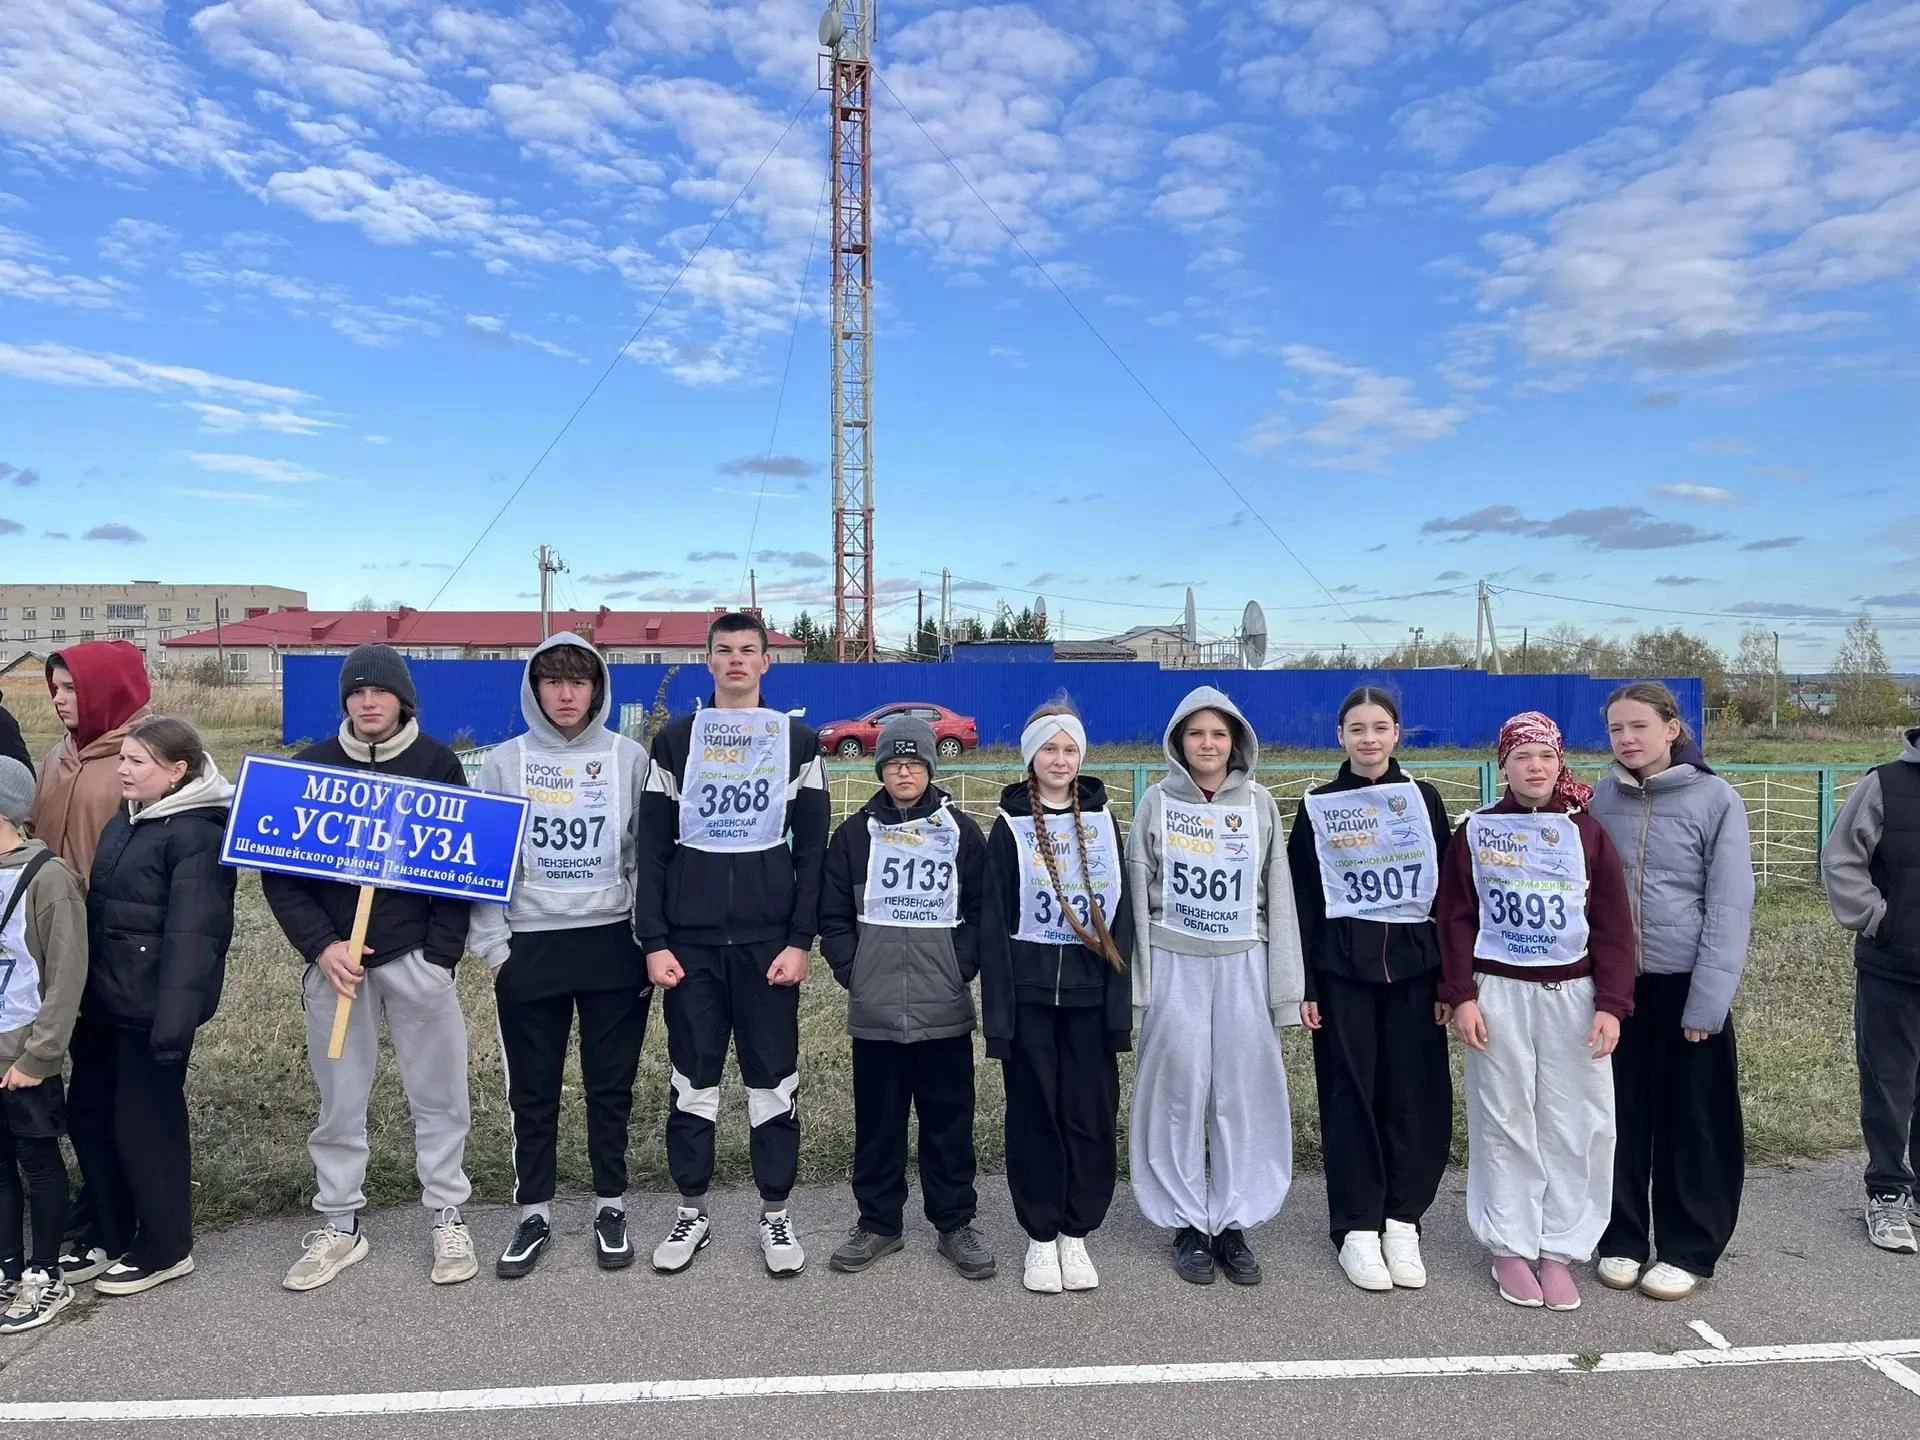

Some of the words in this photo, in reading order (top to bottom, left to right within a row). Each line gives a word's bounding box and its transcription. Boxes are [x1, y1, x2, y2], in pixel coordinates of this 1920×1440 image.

[704, 722, 742, 734] КРОСС
[703, 735, 752, 747] НАЦИИ
[526, 763, 562, 777] КРОСС
[526, 774, 573, 790] НАЦИИ
[302, 774, 392, 811] МБОУ
[394, 790, 468, 823] СОШ
[527, 788, 574, 805] 2020
[698, 778, 770, 818] 3868
[1166, 809, 1201, 827] КРОСС
[1323, 808, 1364, 821] КРОСС
[532, 815, 606, 850] 5397
[709, 829, 749, 838] ОБЛАСТЬ
[1166, 820, 1214, 840] НАЦИИ
[1326, 818, 1379, 834] НАЦИИ
[257, 814, 280, 836] с.
[292, 806, 477, 866] УСТЬ-УЗА
[1329, 832, 1377, 849] 2021
[1167, 833, 1215, 857] 2020
[234, 837, 334, 864] Шемышейского
[335, 854, 380, 871] района
[384, 860, 456, 882] Пензенской
[457, 871, 505, 889] области
[537, 856, 602, 868] ПЕНЗЕНСКАЯ
[546, 870, 594, 880] ОБЛАСТЬ
[881, 857, 953, 891] 5133
[1172, 861, 1242, 902] 5361
[1343, 863, 1422, 904] 3907
[884, 896, 944, 908] ПЕНЗЕНСКАЯ
[1489, 888, 1567, 931] 3893
[892, 910, 938, 921] ОБЛАСТЬ
[1175, 902, 1238, 921] ПЕНЗЕНСКАЯ
[1183, 917, 1229, 934] ОБЛАСТЬ
[1501, 930, 1557, 945] ПЕНЗЕНСКАЯ
[1507, 942, 1549, 954] ОБЛАСТЬ
